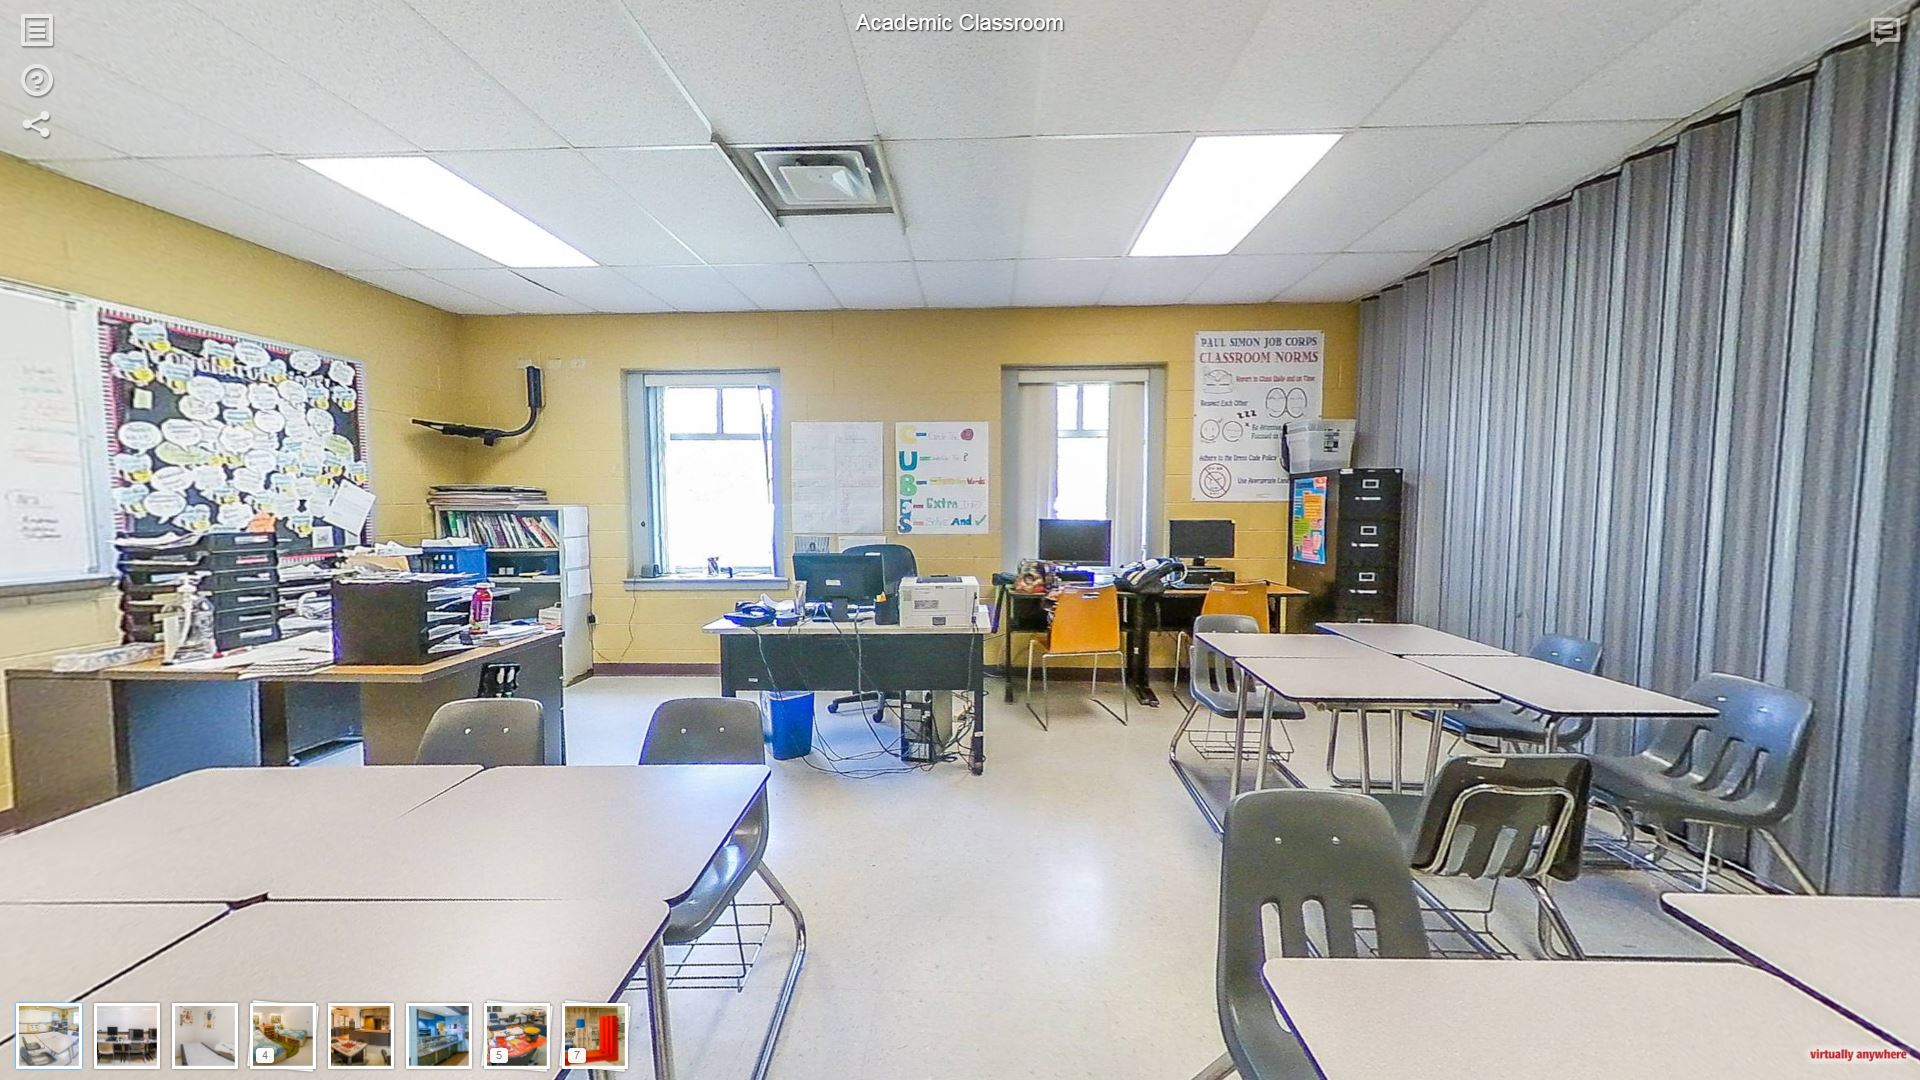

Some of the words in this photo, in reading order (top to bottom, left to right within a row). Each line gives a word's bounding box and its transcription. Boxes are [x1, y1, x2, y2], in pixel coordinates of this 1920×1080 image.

[1201, 338, 1226, 348] PAUL
[1229, 337, 1260, 347] SIMON
[1264, 337, 1282, 349] JOB
[1285, 337, 1318, 347] CORPS
[1200, 352, 1271, 364] CLASSROOM
[1275, 351, 1319, 363] NORMS
[926, 498, 958, 509] Extra
[950, 514, 972, 526] And
